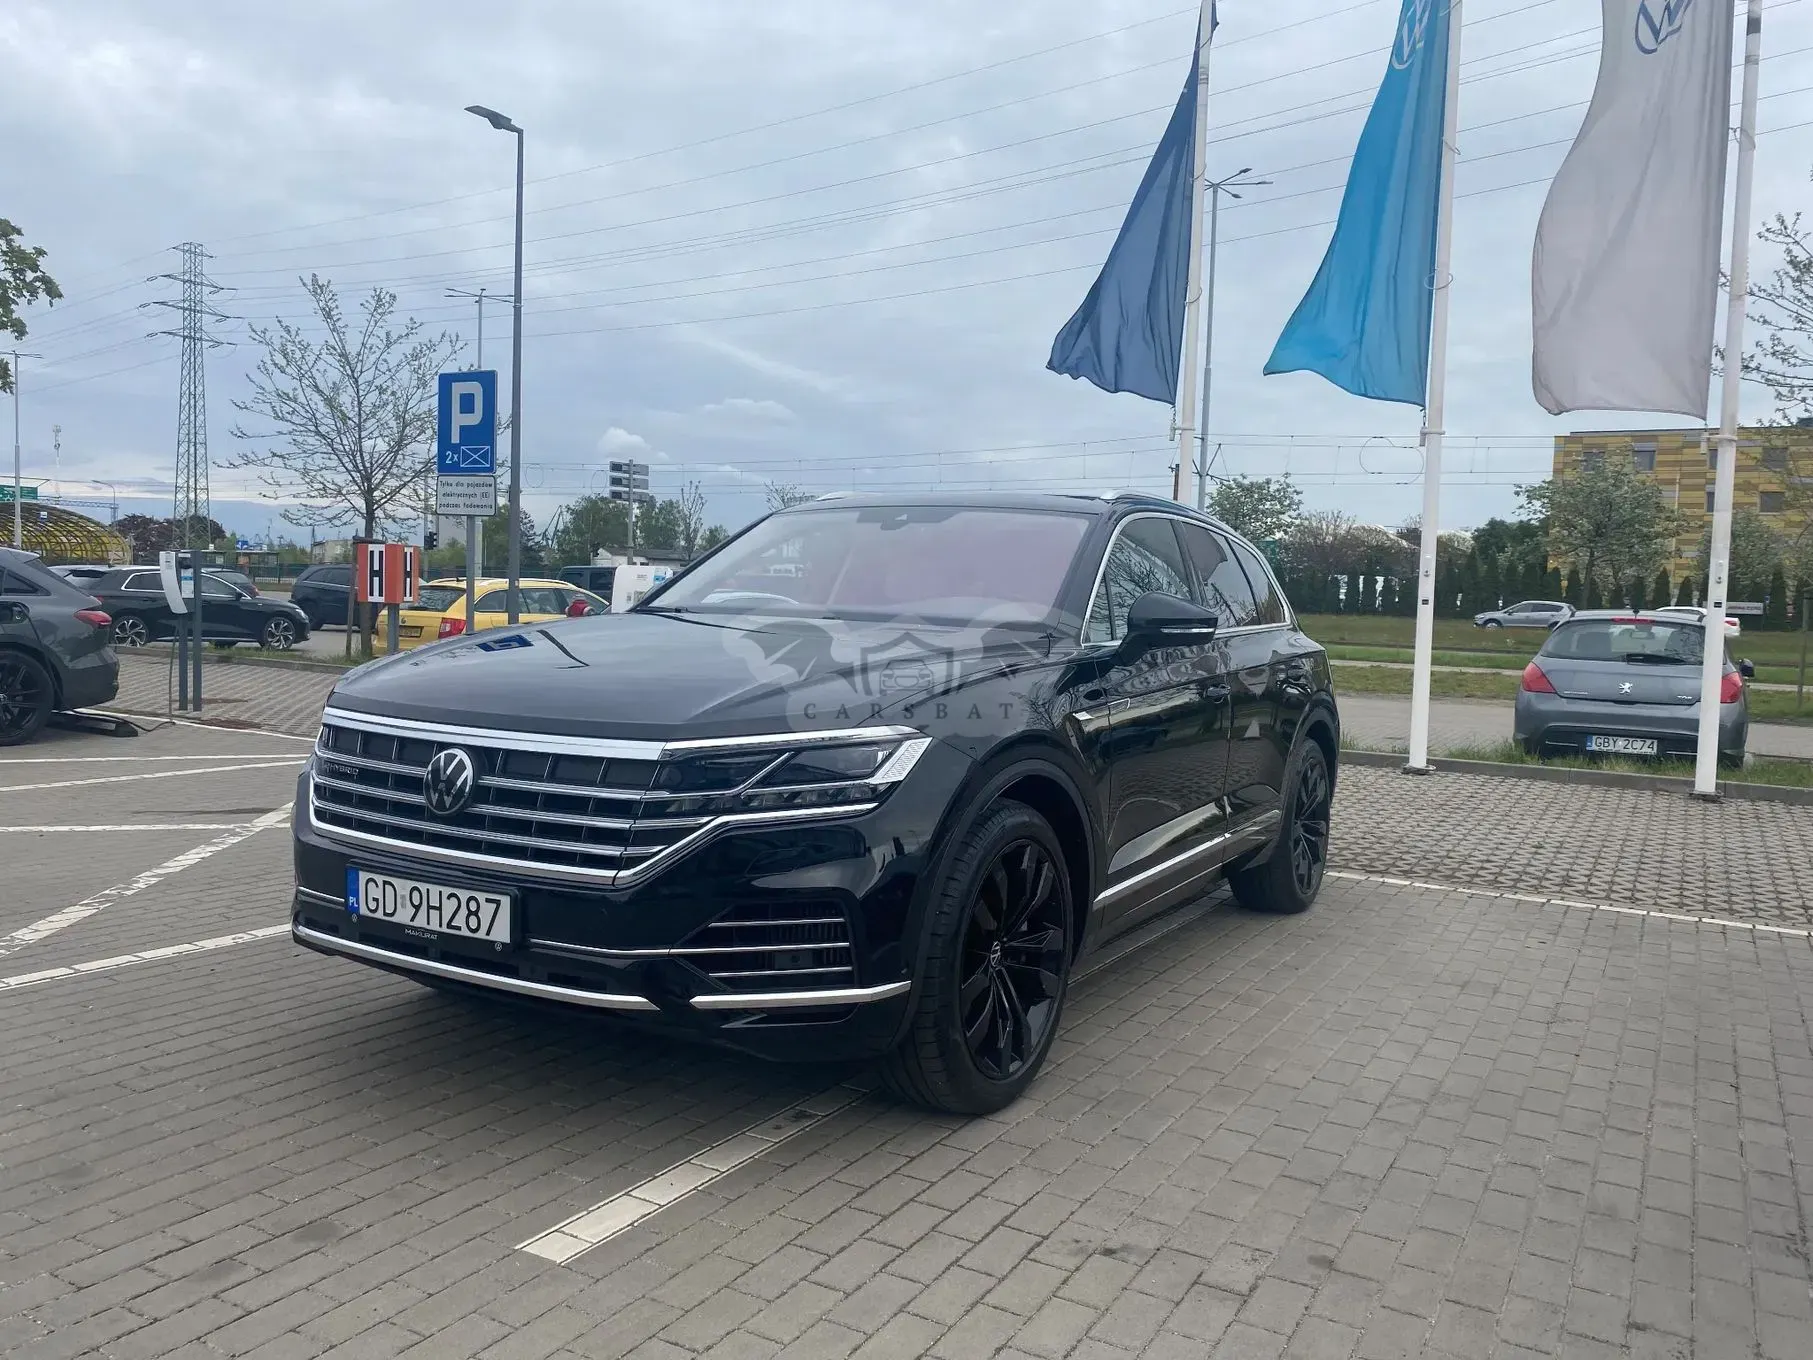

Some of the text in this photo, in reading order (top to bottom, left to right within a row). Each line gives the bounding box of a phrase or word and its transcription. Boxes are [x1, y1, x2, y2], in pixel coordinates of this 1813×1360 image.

[452, 382, 483, 444] P
[446, 451, 459, 463] 2x
[1595, 736, 1655, 751] GBY 2C74
[349, 896, 358, 907] PL
[365, 877, 501, 937] GD 9H287
